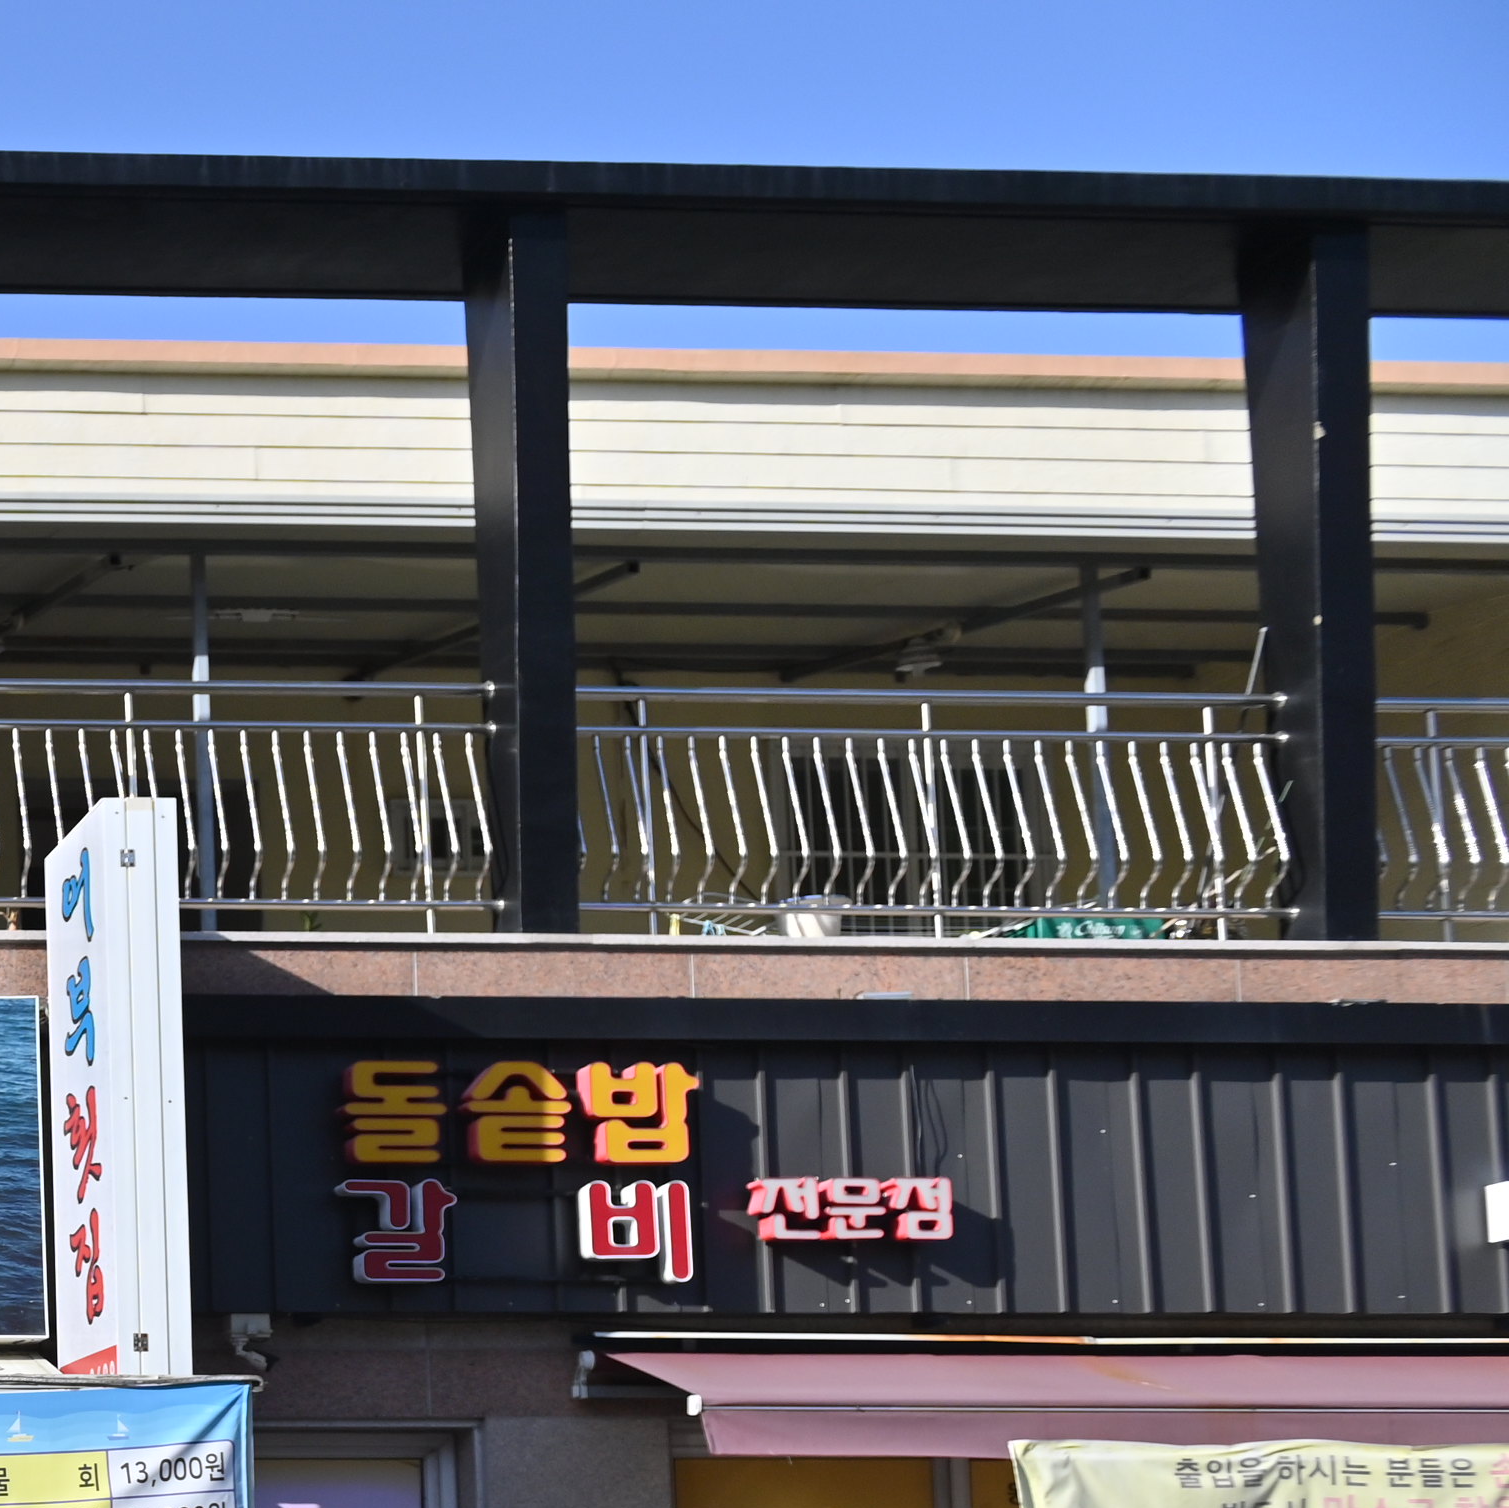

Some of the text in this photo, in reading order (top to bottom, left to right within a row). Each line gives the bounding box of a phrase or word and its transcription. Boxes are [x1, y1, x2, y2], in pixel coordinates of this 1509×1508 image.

[61, 847, 104, 1324] 어부횟집
[747, 1177, 953, 1240] 전문점
[120, 1451, 226, 1485] 13,000원
[1175, 1456, 1264, 1489] 출입을
[1277, 1454, 1372, 1487] 하시는
[1386, 1456, 1477, 1488] 분들은
